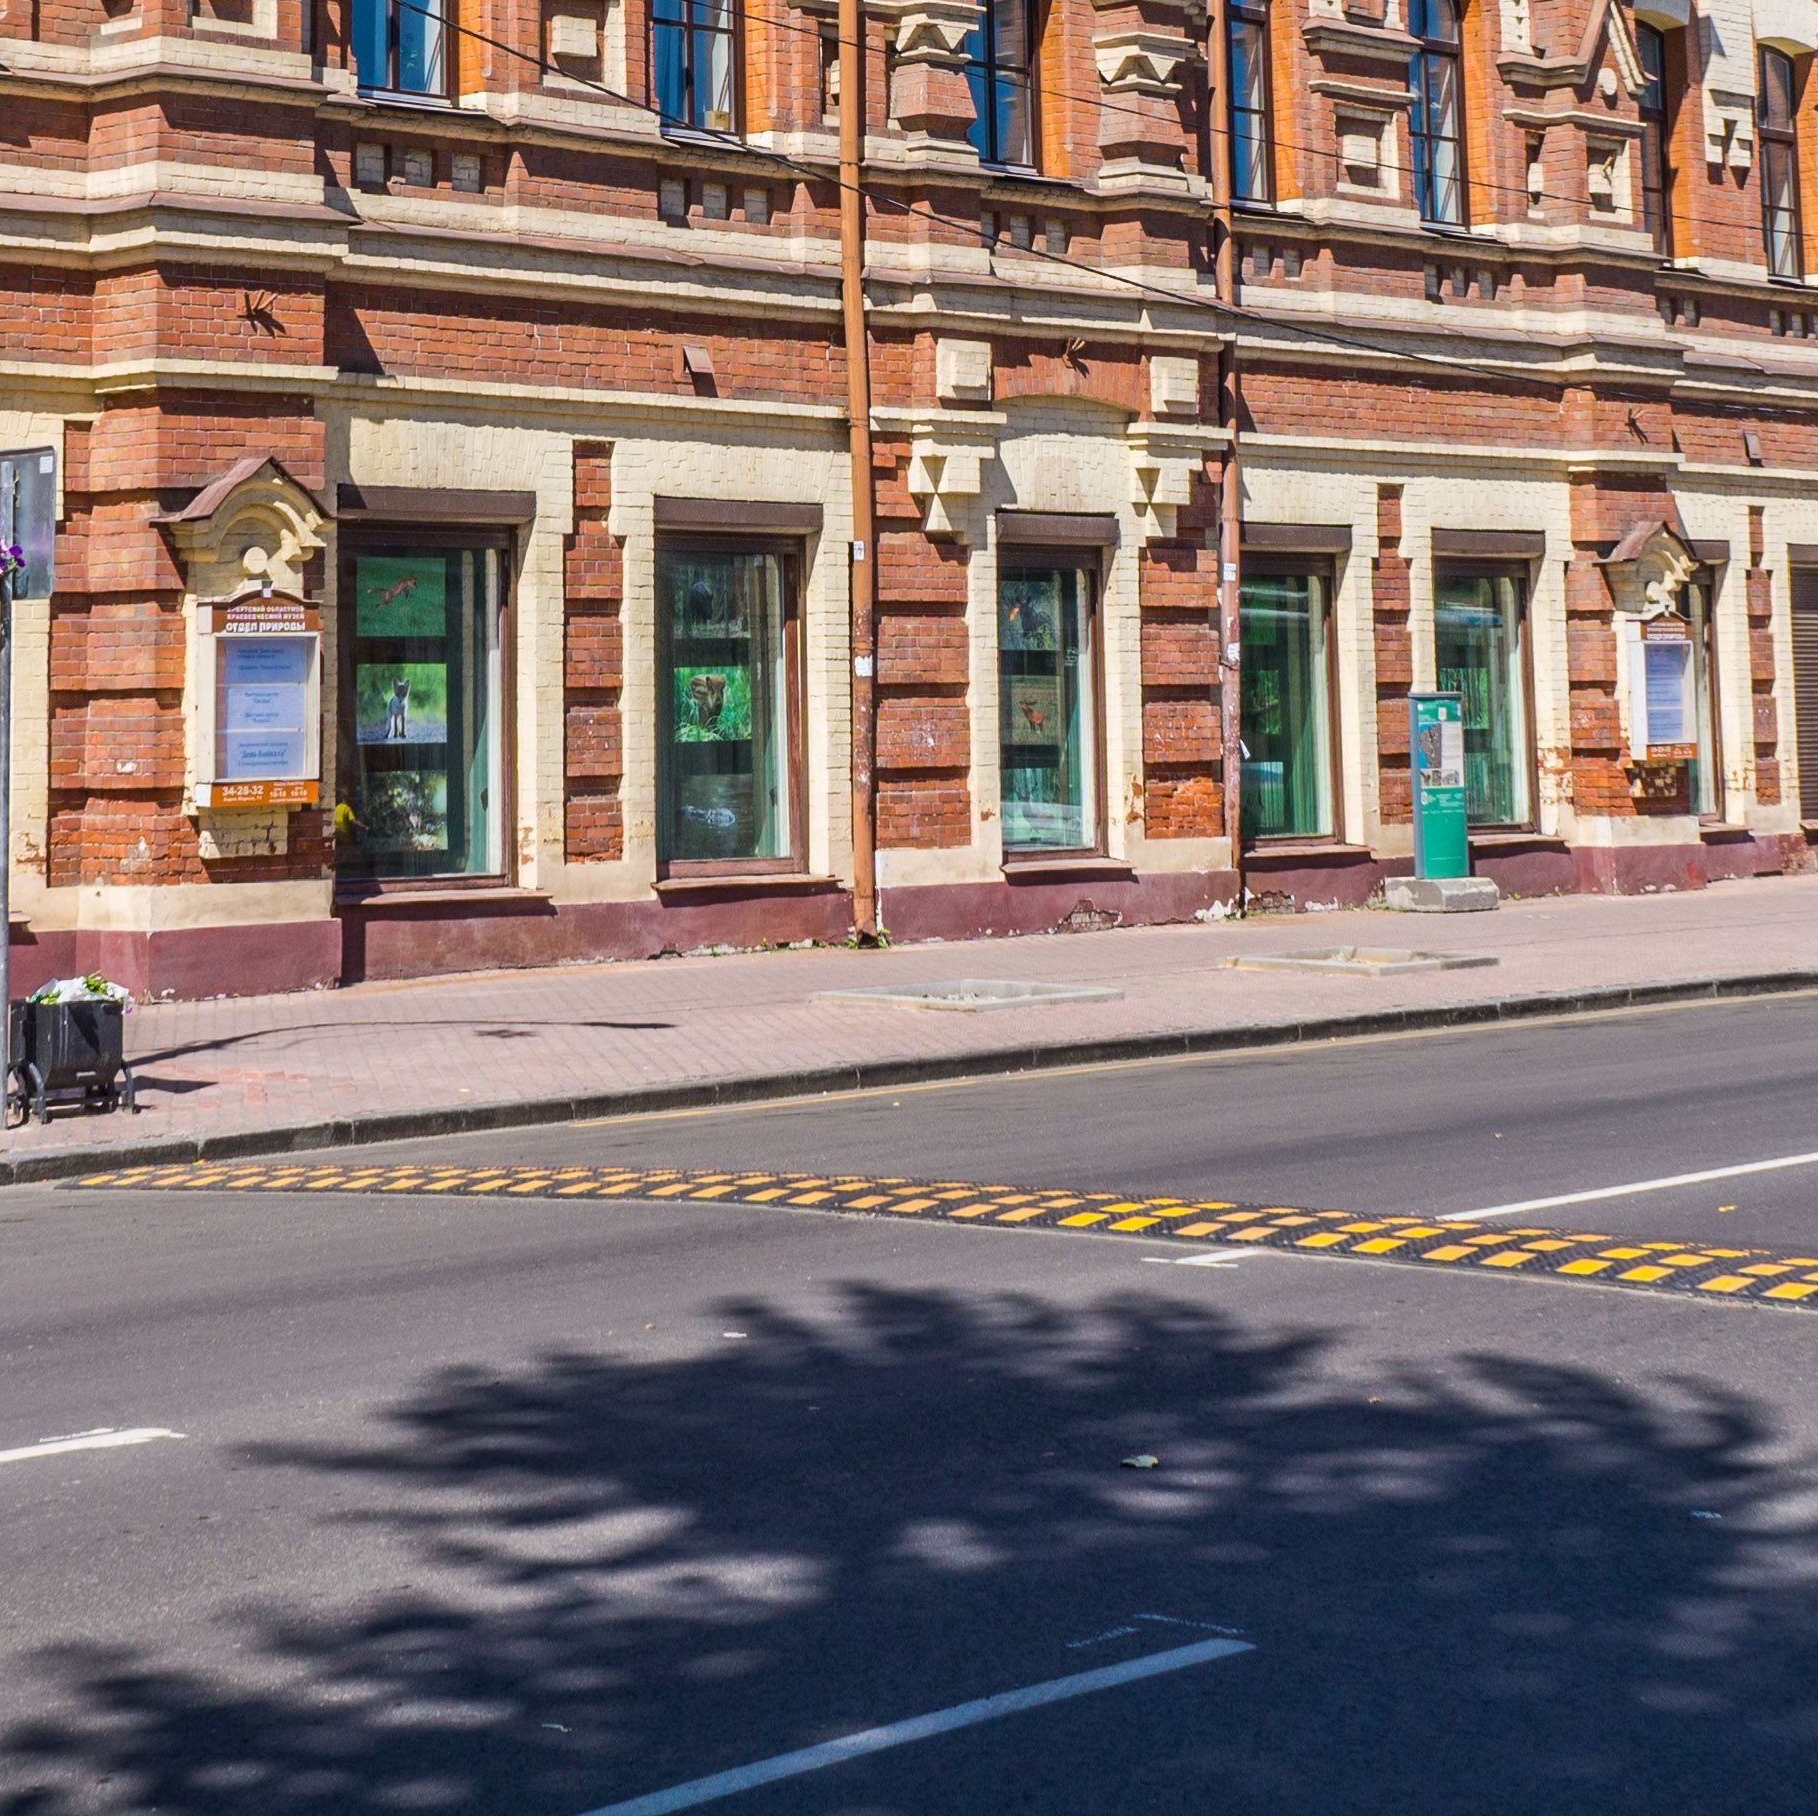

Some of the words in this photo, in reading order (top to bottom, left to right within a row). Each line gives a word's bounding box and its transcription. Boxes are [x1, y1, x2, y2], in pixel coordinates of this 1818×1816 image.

[226, 622, 258, 632] ОТДЕЛ
[259, 621, 306, 632] ПРИРОДЫ
[222, 785, 264, 796] 34-28-32
